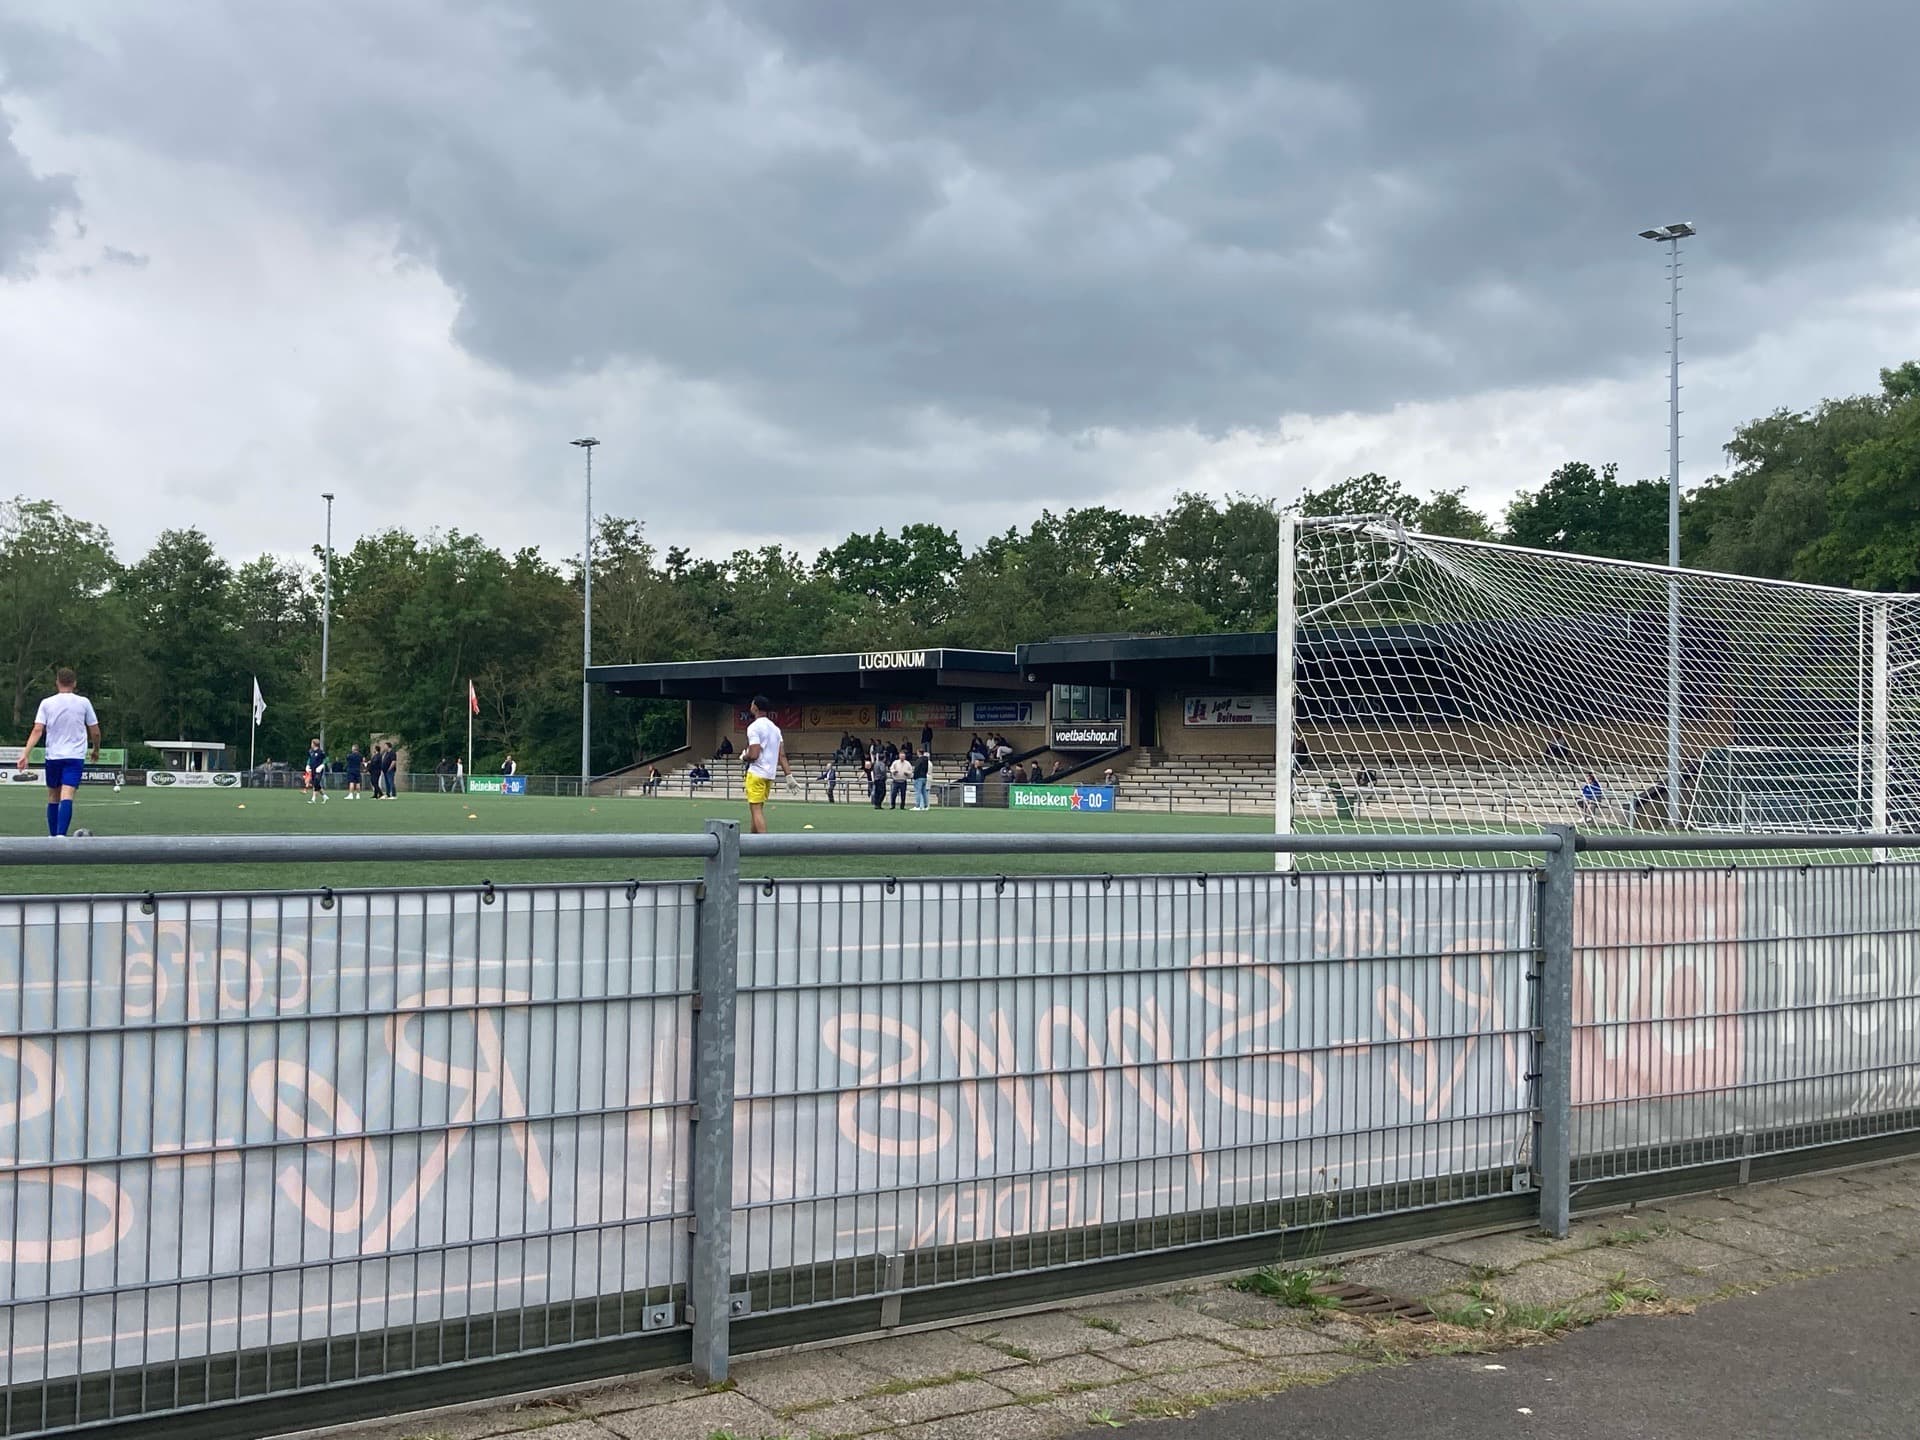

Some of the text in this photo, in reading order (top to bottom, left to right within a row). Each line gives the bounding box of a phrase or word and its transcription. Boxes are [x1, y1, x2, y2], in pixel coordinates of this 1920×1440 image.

[858, 652, 926, 670] LUGDUNUM
[1055, 728, 1118, 745] voetbalshop.nl
[470, 780, 500, 792] Heineken
[1014, 791, 1068, 806] Heineken
